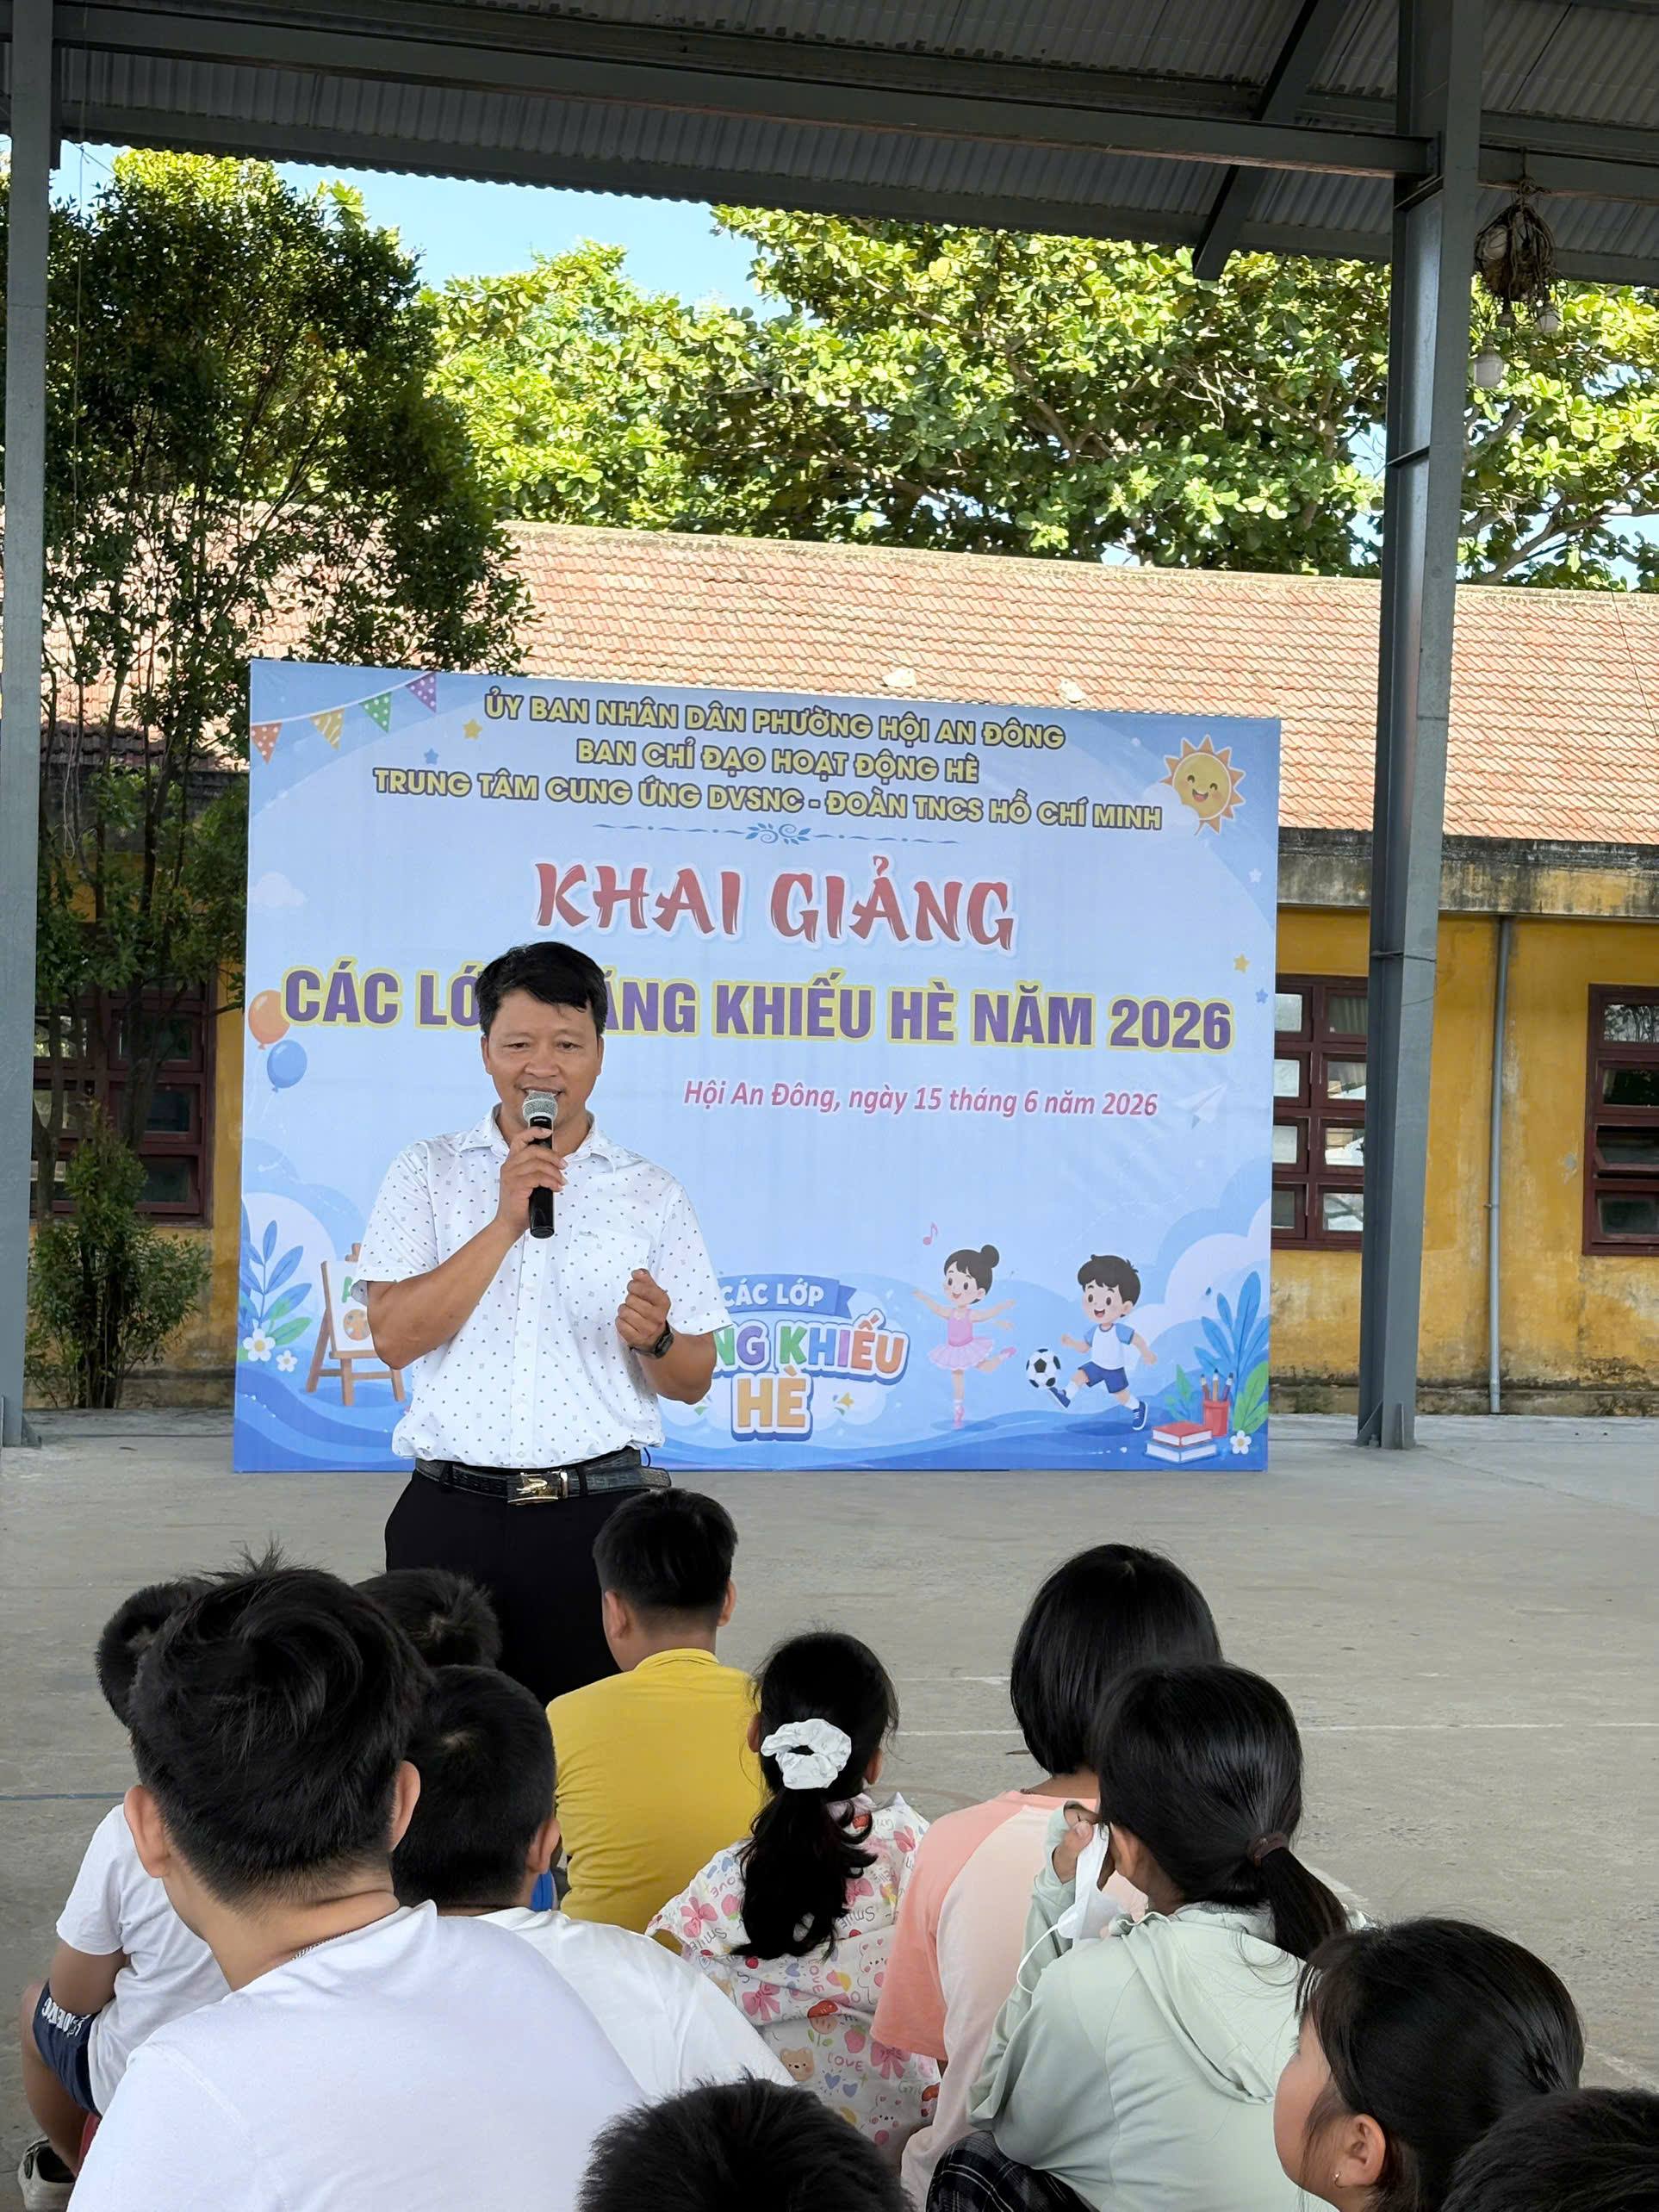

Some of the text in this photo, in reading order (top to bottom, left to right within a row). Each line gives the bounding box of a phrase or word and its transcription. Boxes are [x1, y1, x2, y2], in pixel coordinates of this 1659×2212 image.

[485, 686, 1066, 749] ỦY BAN NHÂN DÂN PHƯỜNG HỘI AN ĐÔNG
[577, 736, 979, 785] BAN CHỈ ĐẠO HOẠT ĐỘNG HÈ
[373, 767, 1162, 830] TRUNG TÂM CUNG ỨNG DVSNC - ĐOÀN TNCS HỒ CHÍ MINH
[535, 854, 1014, 951] KHAI GIẢNG
[283, 959, 401, 1026] CÁC
[715, 971, 873, 1041] KHIẾU
[890, 981, 955, 1041] HÈ
[973, 983, 1094, 1047] NĂM
[1109, 998, 1233, 1052] 2026
[684, 1078, 1158, 1117] Hội An Đông, ngày 15 tháng 6 năm 2026
[721, 1277, 824, 1308] CÁC LỚP
[713, 1314, 904, 1374] NG KHIẾU
[737, 1364, 807, 1428] HÈ
